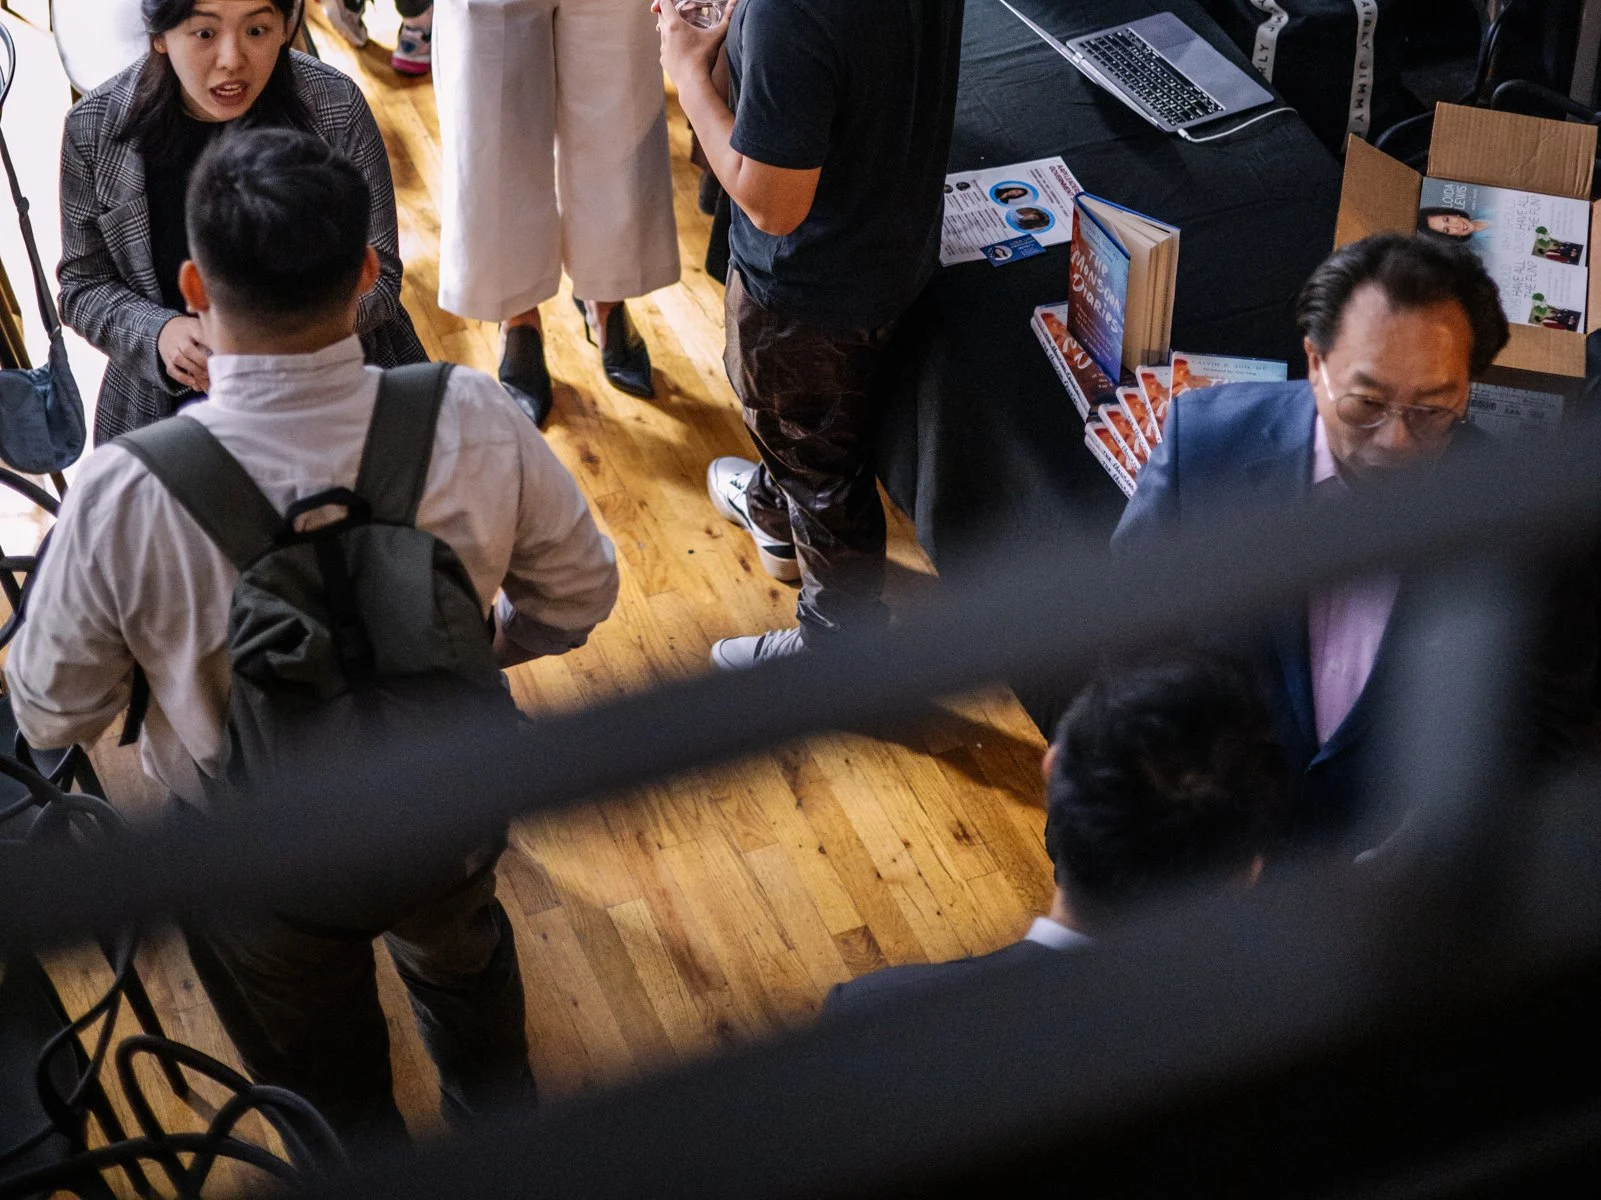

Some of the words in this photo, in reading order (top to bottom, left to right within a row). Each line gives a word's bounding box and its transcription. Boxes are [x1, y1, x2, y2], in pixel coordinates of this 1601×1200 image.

[1355, 60, 1368, 123] JIMMY
[1442, 184, 1455, 208] LOIDA
[1454, 185, 1467, 210] LEWIS
[1518, 195, 1529, 209] ALL
[1515, 209, 1527, 230] HAVE
[1528, 216, 1539, 232] THE
[1514, 260, 1526, 275] ALL
[1512, 276, 1525, 297] HAVE
[1524, 282, 1536, 298] THE
